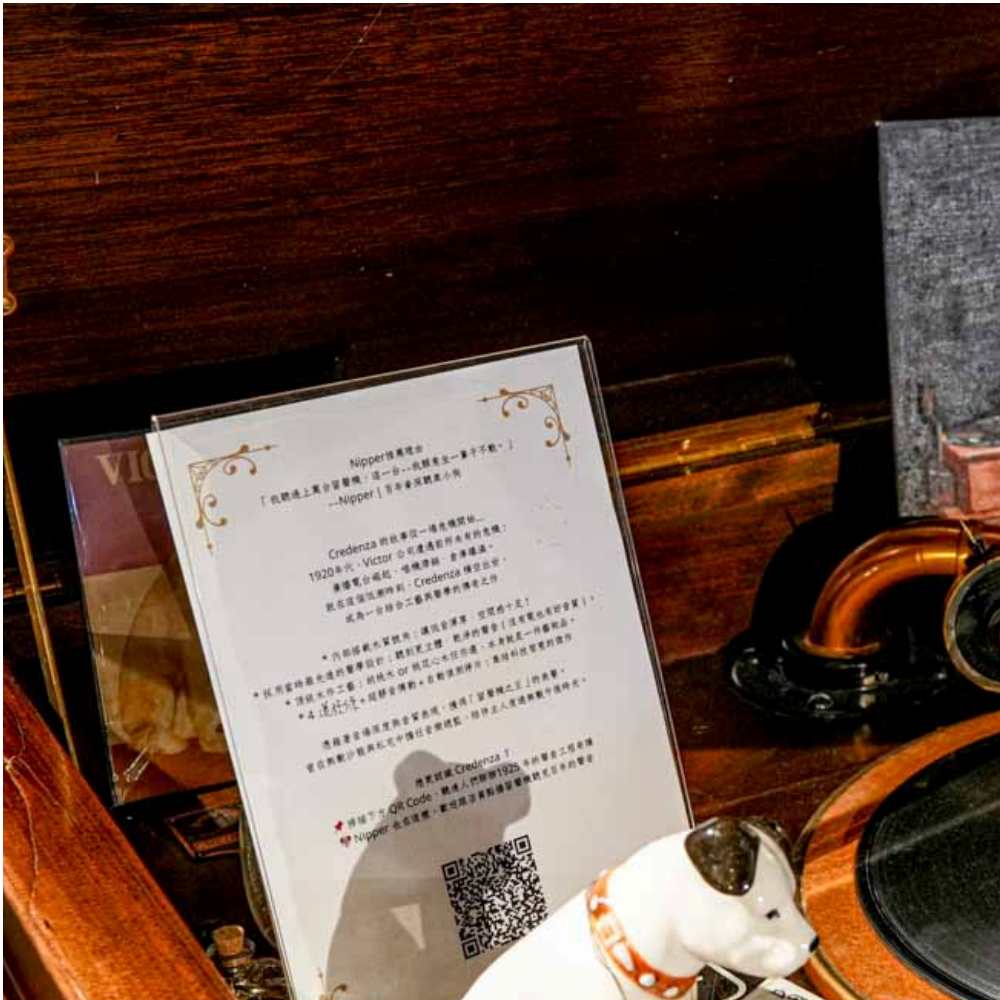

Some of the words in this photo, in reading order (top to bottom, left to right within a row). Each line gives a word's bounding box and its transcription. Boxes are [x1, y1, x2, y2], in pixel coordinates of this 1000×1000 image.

[328, 539, 378, 561] Credenza
[397, 666, 409, 678] or
[388, 801, 404, 815] QR
[354, 824, 389, 844] Nipper
